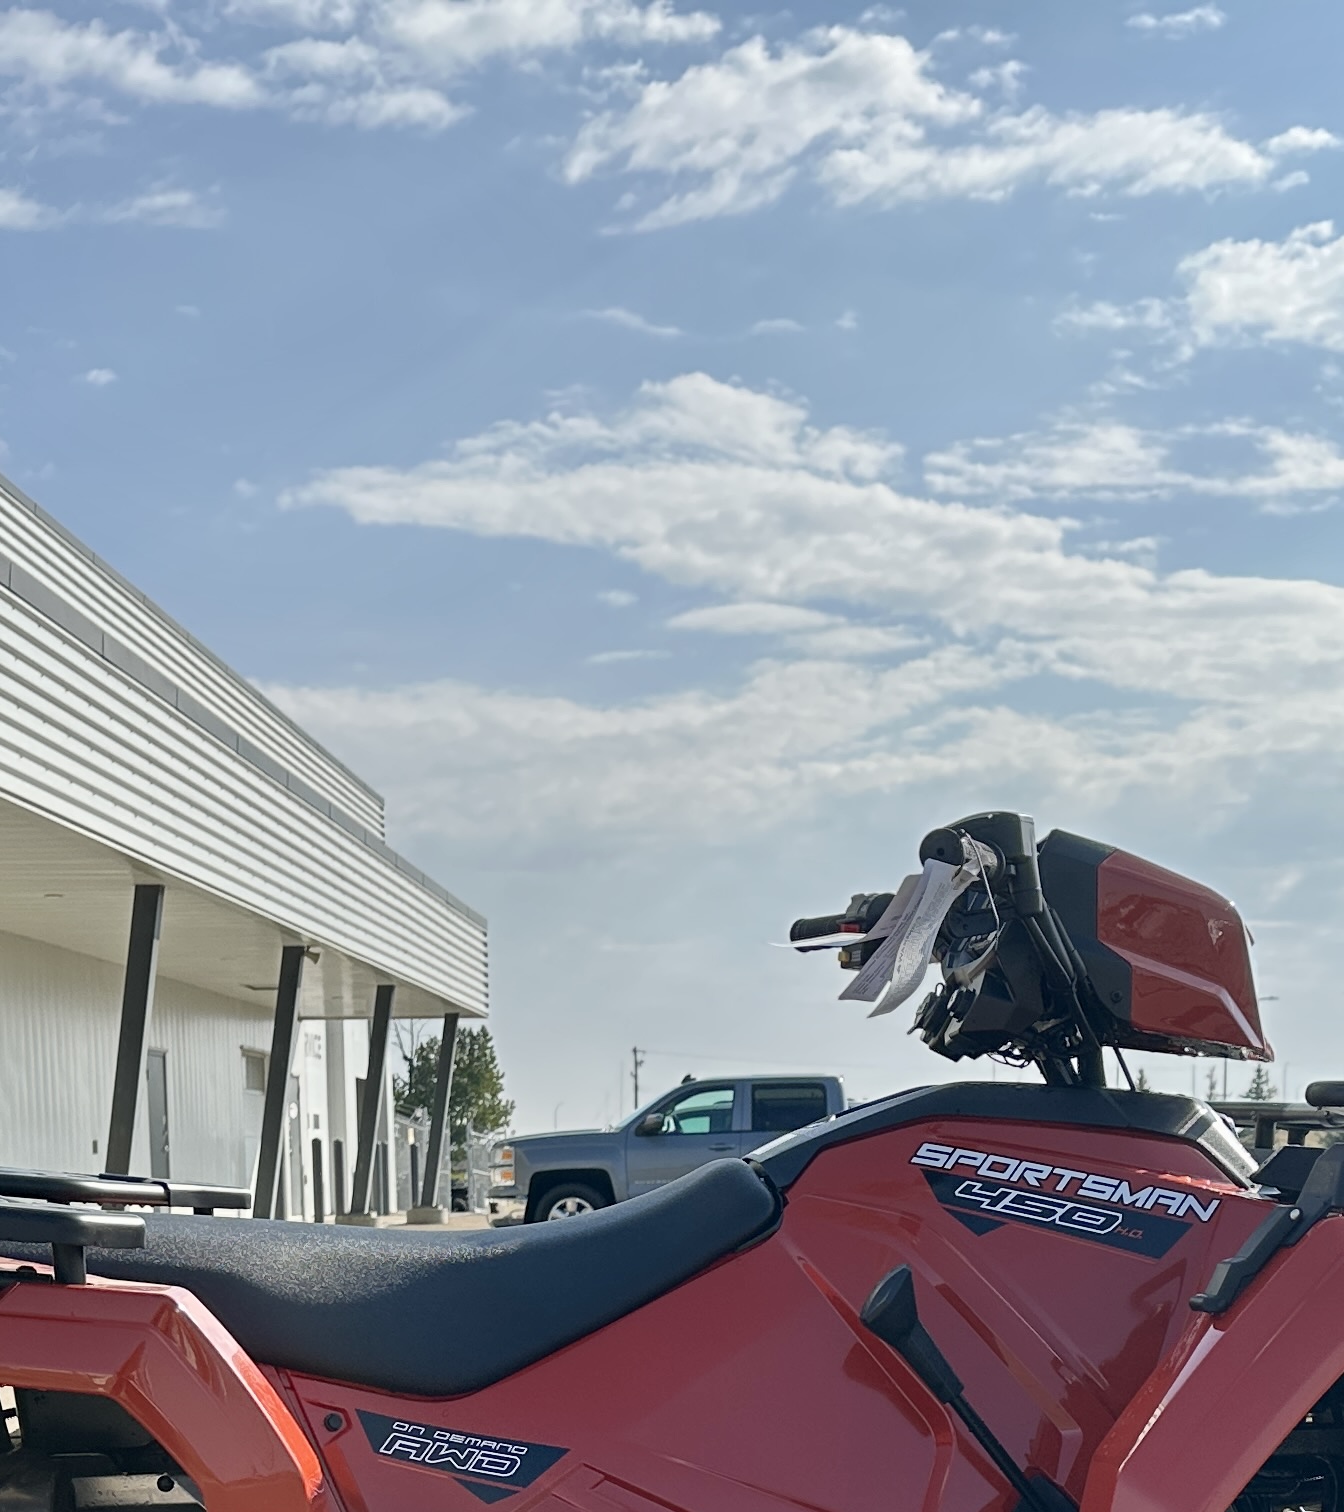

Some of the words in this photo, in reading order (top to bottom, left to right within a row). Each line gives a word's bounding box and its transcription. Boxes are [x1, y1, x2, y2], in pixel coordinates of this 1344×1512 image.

[910, 1142, 1221, 1222] SPORTSMAN
[955, 1180, 1123, 1235] 450
[379, 1432, 522, 1477] AWD
[433, 1431, 528, 1454] DEMAND
